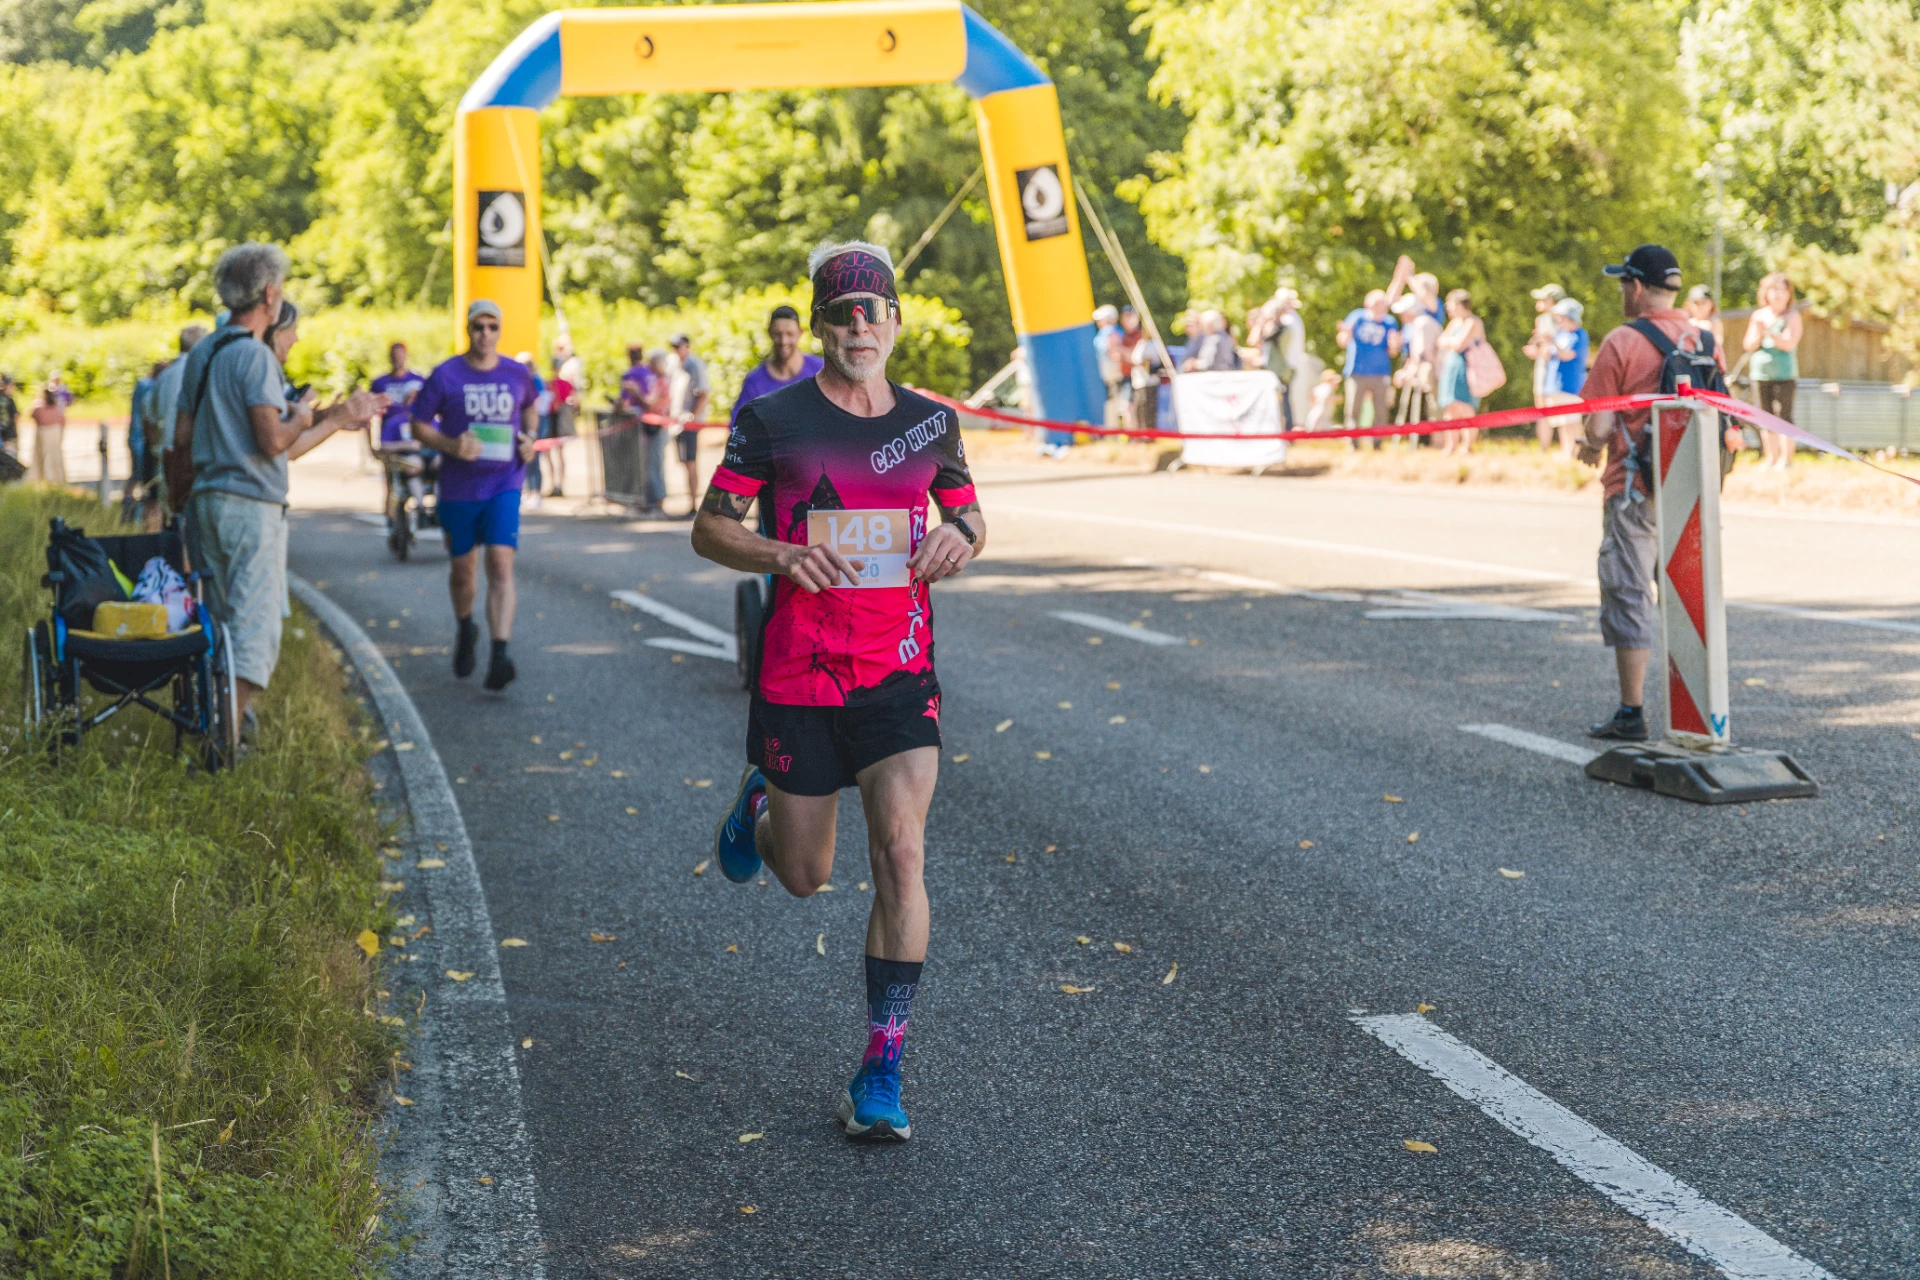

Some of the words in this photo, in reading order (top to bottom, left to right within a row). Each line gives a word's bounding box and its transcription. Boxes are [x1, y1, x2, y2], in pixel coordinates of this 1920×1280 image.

[824, 251, 875, 278] CAP
[824, 268, 888, 300] HUNT
[464, 391, 514, 416] DUO
[870, 437, 906, 474] CAP
[905, 411, 947, 452] HUNT
[827, 515, 893, 552] 148
[882, 1000, 913, 1016] HUN
